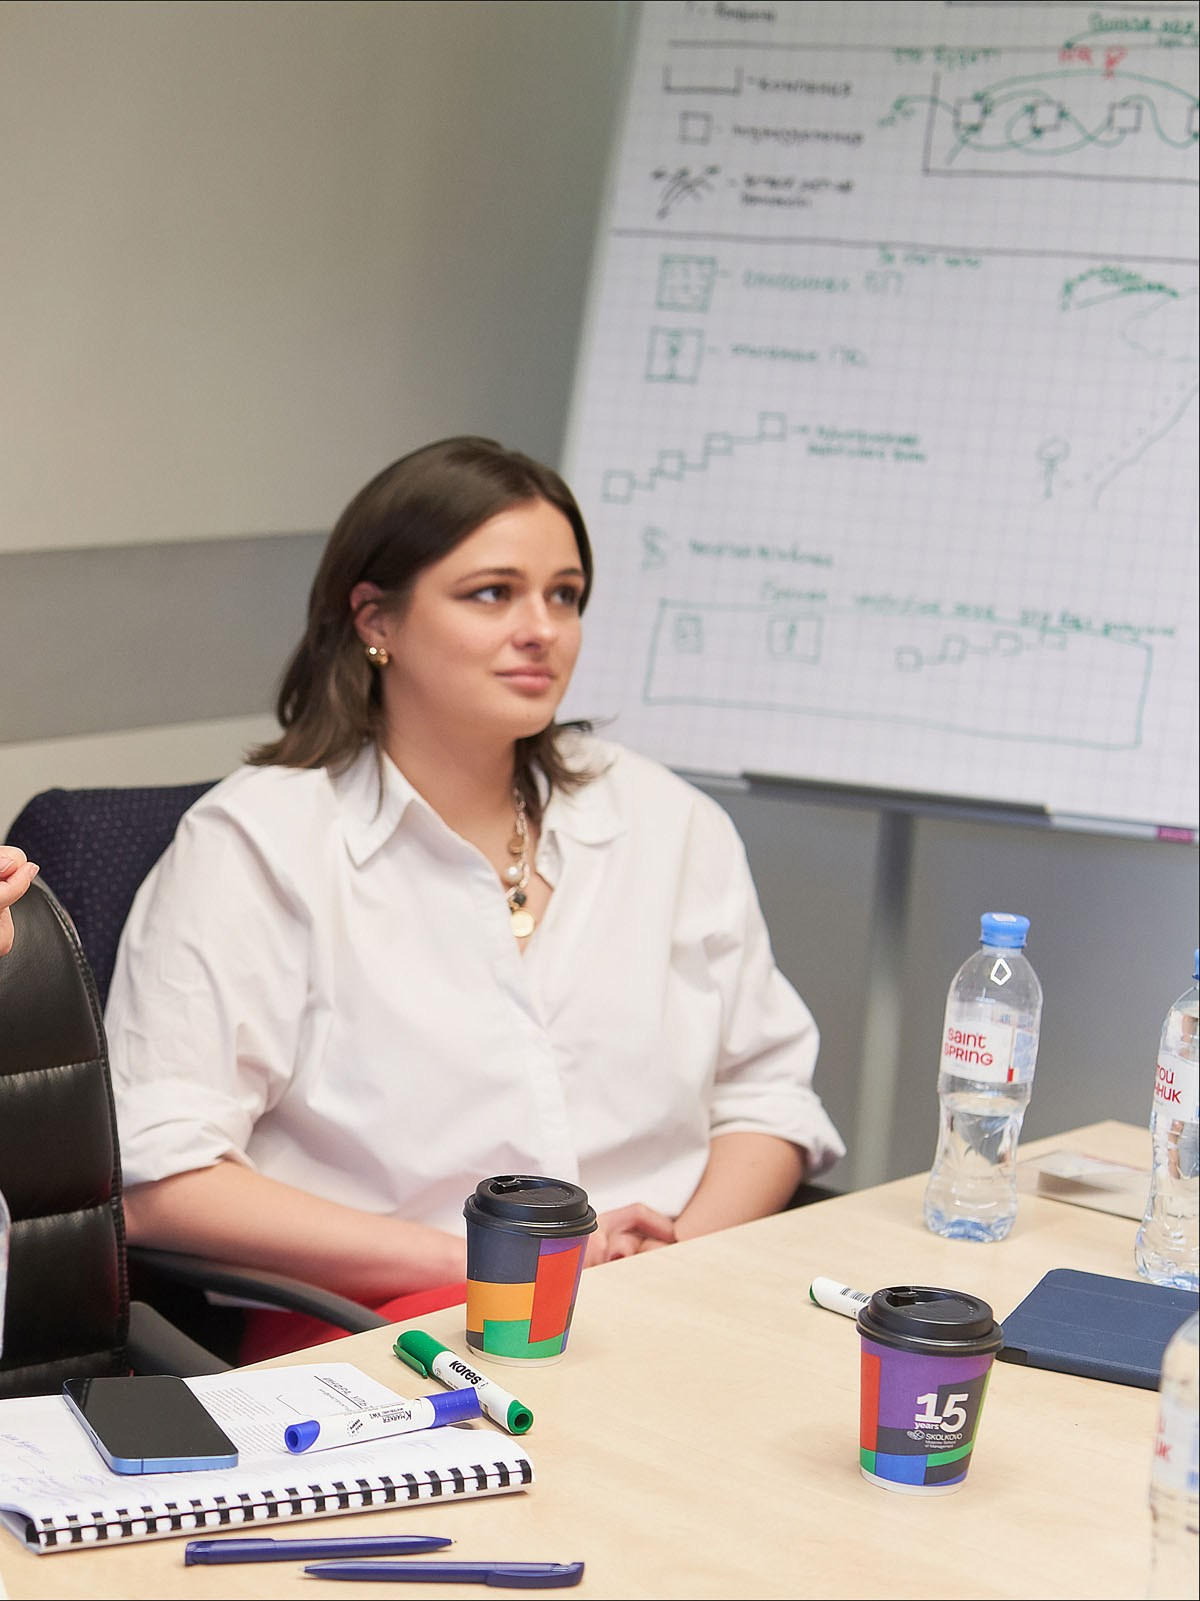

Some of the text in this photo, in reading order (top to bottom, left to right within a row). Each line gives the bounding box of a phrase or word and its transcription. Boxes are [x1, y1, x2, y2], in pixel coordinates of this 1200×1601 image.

[448, 1359, 483, 1385] Kores
[914, 1392, 969, 1433] 15
[913, 1421, 940, 1430] years
[925, 1432, 963, 1441] SKOLKOVO
